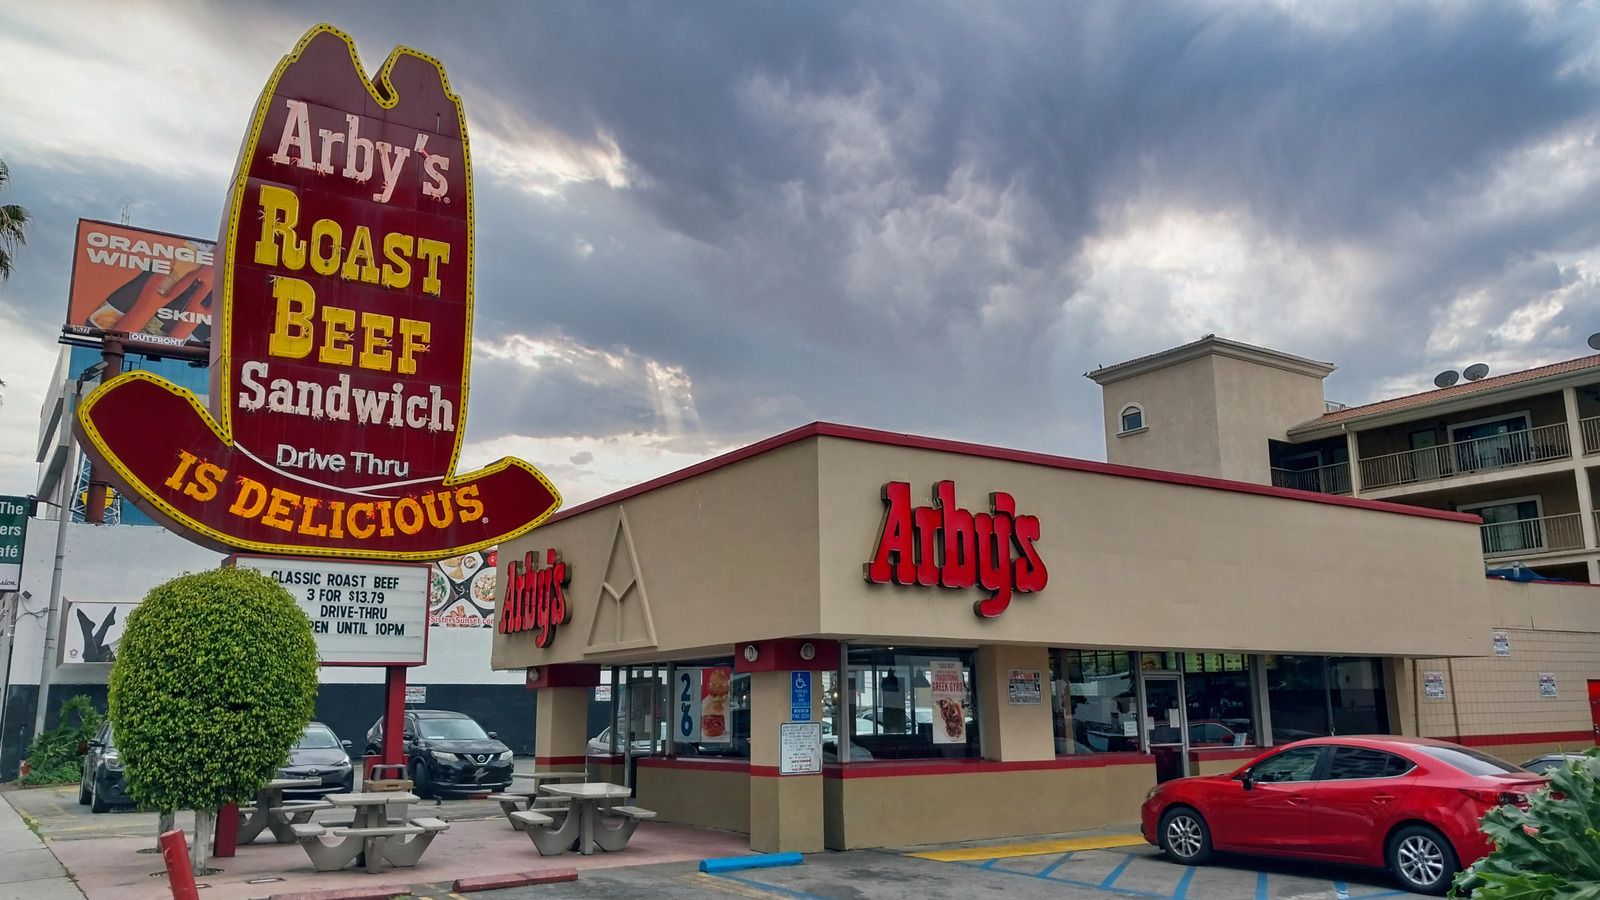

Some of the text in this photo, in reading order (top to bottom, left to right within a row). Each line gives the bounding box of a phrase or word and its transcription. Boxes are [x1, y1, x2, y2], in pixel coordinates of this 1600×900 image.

[271, 100, 449, 203] Arby's
[87, 232, 214, 266] ORANGE
[254, 184, 450, 297] ROAST
[86, 248, 171, 275] WINE
[157, 307, 212, 326] SKIN
[269, 276, 431, 375] BEEF
[130, 333, 184, 346] OUTFRONT
[238, 361, 455, 432] Sandwich
[276, 443, 409, 478] Drive Thru
[0, 502, 24, 515] The
[164, 449, 485, 539] IS DELICIOUS
[866, 480, 1048, 618] Arby's
[271, 570, 400, 589] CLASSIC ROAST BEEF
[307, 588, 385, 604] 3 FOR $13.79
[320, 605, 388, 620] DRIVE-THRU
[499, 548, 569, 648] Arby's
[337, 621, 368, 635] UNTIL
[375, 623, 405, 636] 10PM
